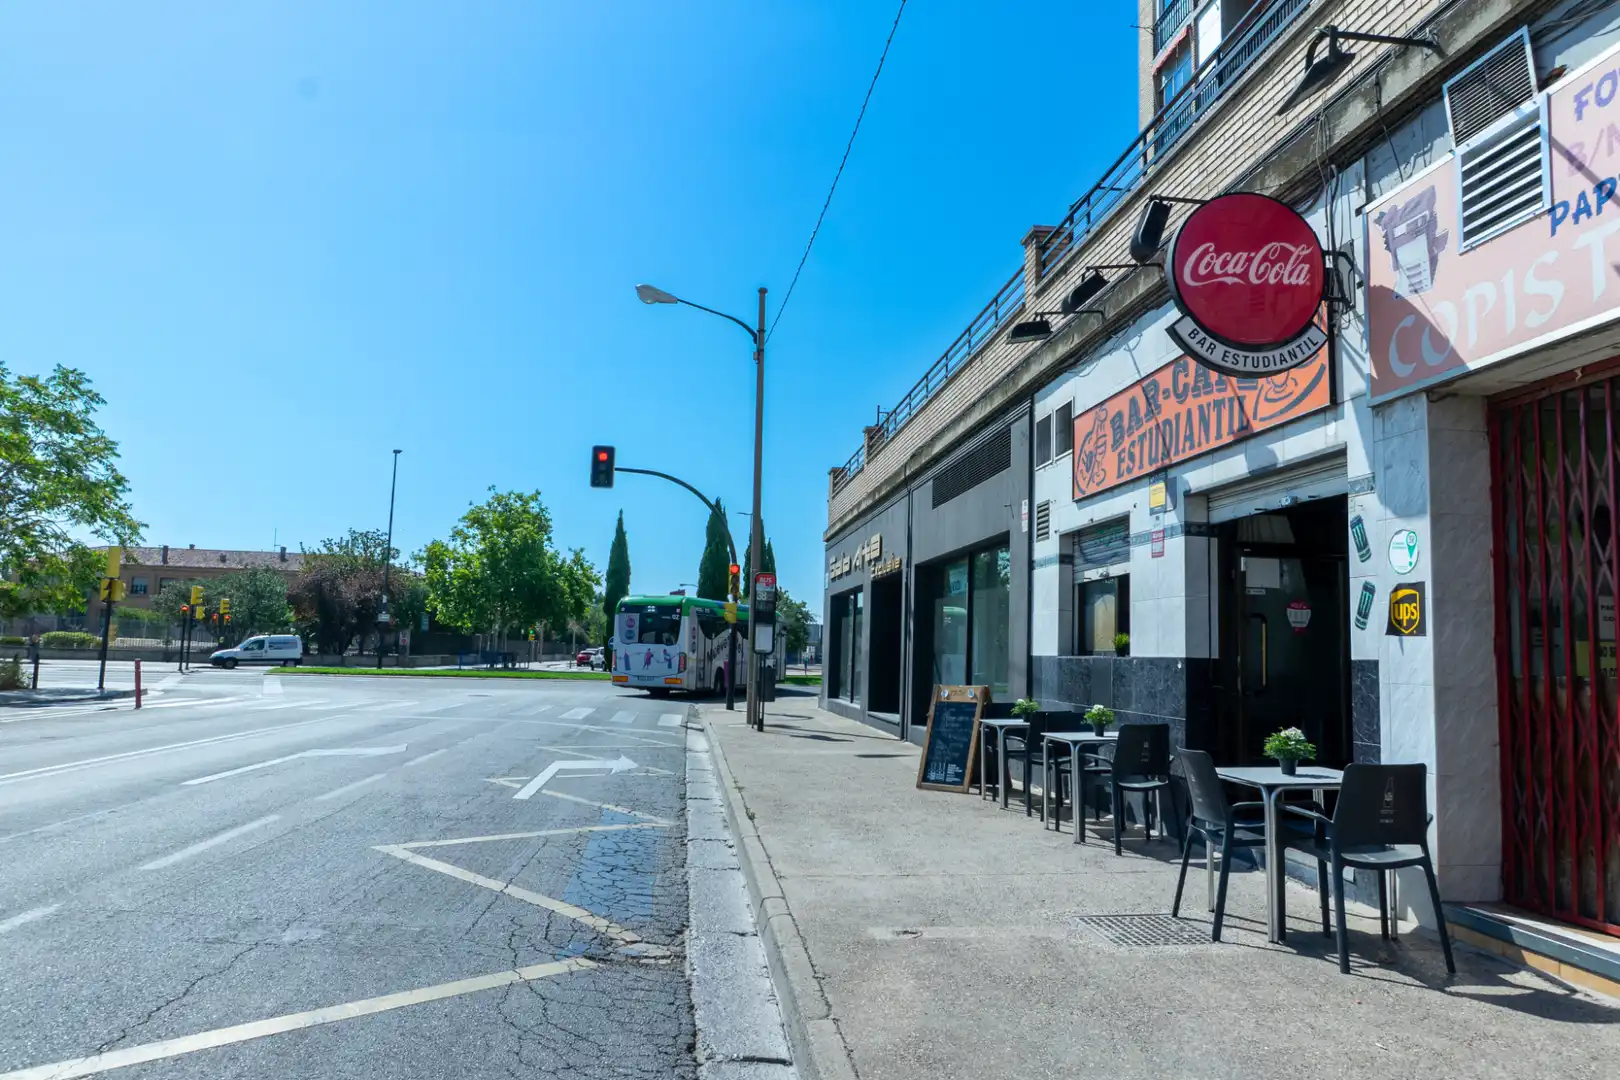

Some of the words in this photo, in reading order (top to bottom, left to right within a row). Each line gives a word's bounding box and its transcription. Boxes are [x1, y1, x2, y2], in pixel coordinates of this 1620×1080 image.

[1573, 69, 1620, 121] FO
[1547, 173, 1620, 238] PAP
[1183, 242, 1315, 286] Coca-Cola
[1188, 328, 1217, 356] BAR
[1221, 336, 1319, 369] ESTUDIANTIL
[1116, 395, 1249, 480] ESTUDIANTIL
[1394, 603, 1417, 627] ups
